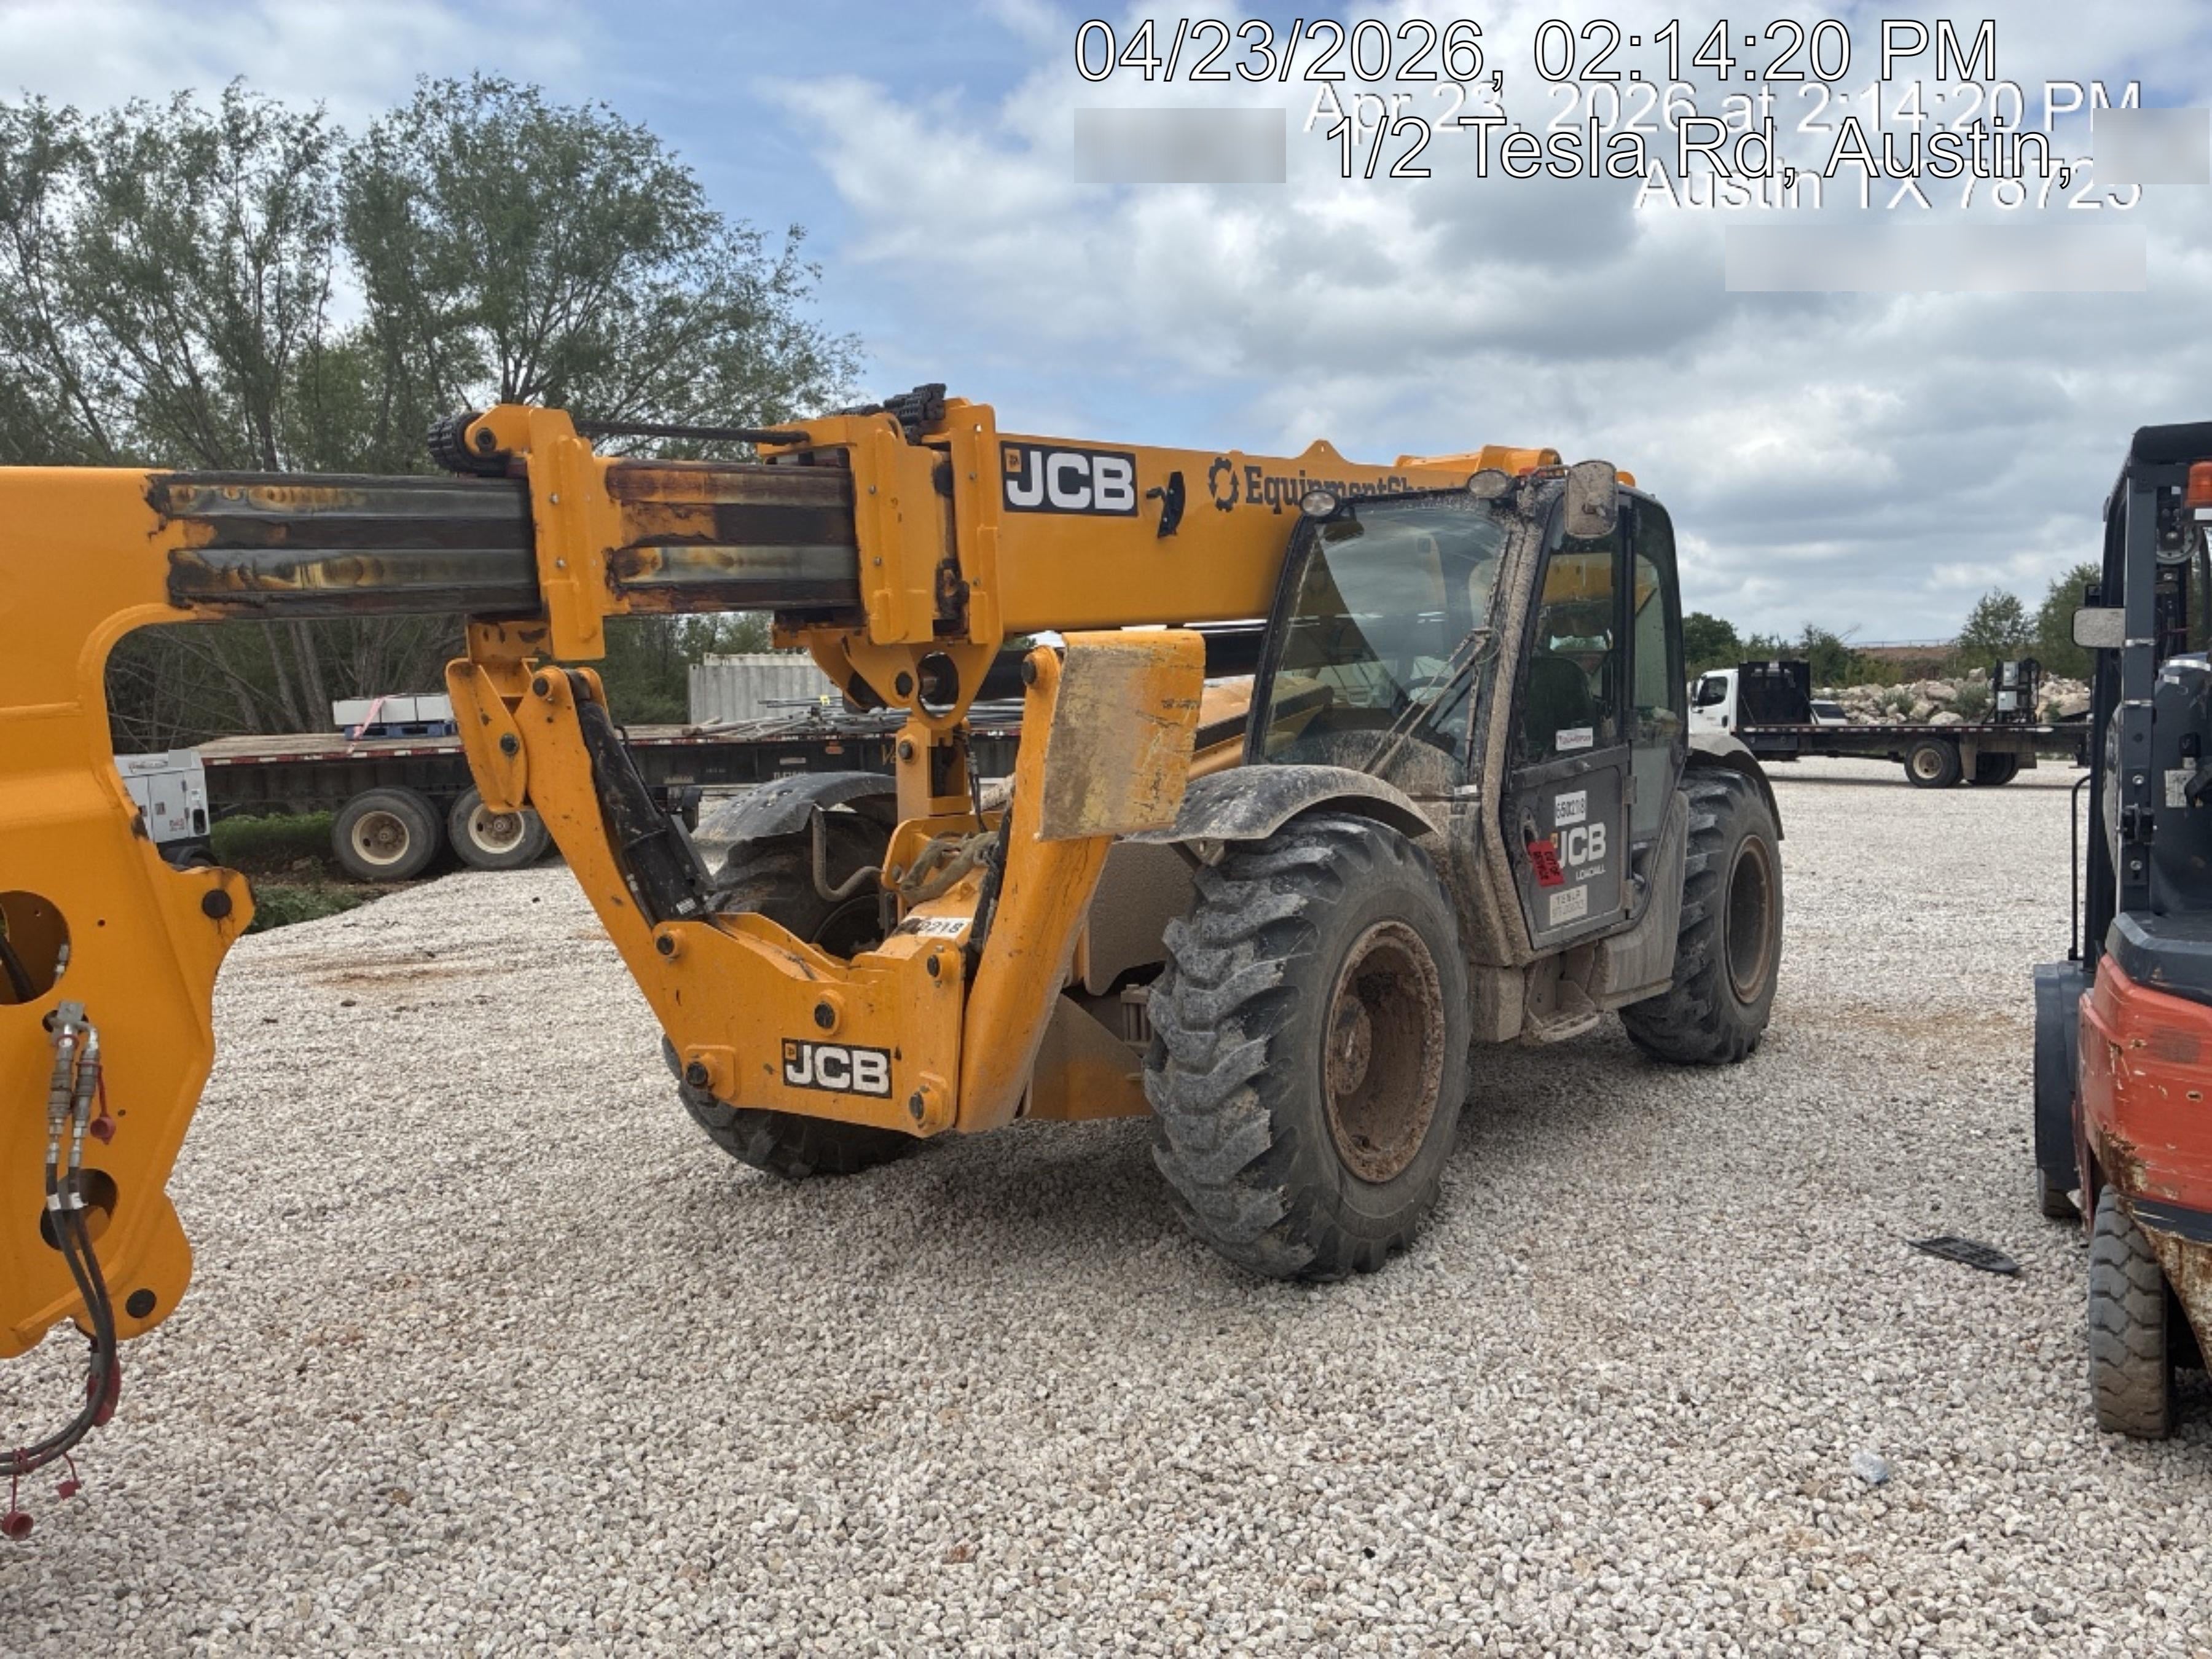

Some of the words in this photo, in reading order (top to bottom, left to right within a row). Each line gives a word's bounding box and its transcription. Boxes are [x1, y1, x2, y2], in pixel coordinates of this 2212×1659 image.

[1006, 450, 1134, 511] JCB
[1558, 822, 1606, 869] JCB
[785, 1045, 890, 1094] JCB
